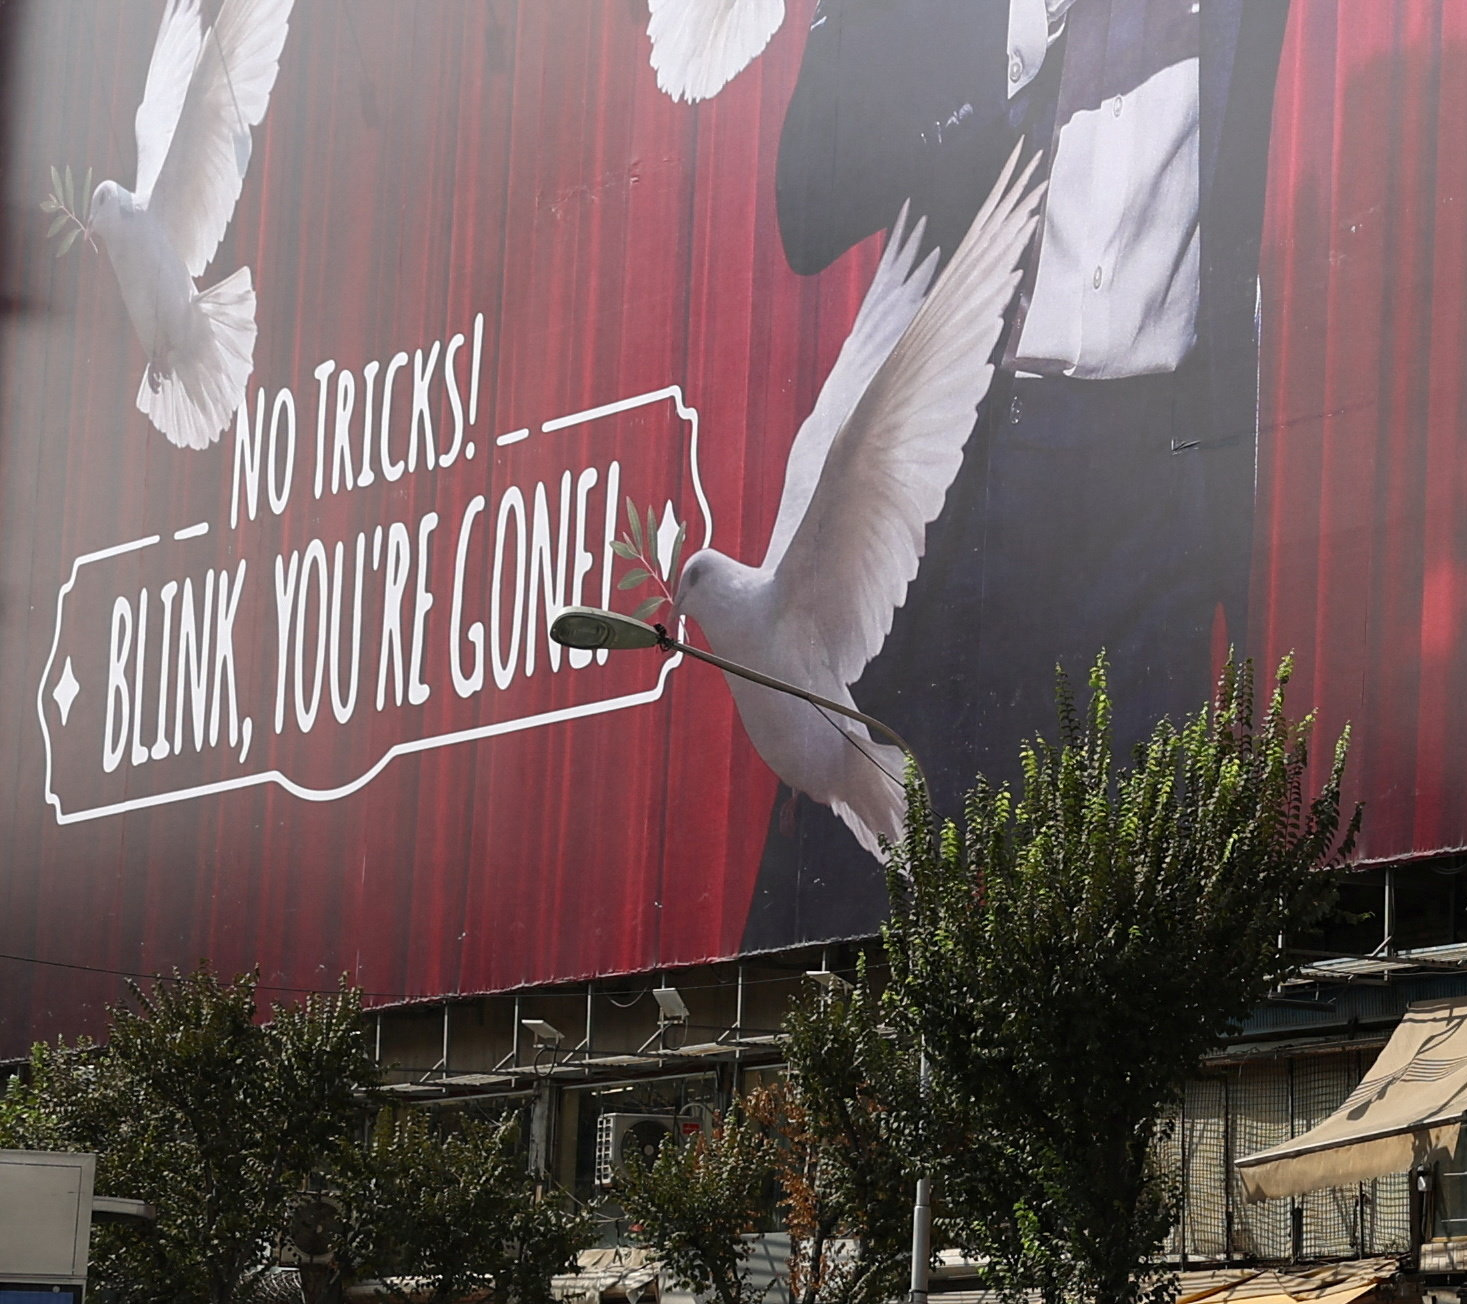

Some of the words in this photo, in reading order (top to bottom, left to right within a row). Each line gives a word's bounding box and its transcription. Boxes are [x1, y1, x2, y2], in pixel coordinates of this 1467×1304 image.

[230, 385, 298, 530] NO
[313, 312, 485, 501] TRICKS!
[103, 558, 253, 774] BLINK,
[273, 511, 439, 736] YOU'RE
[449, 460, 621, 700] GONE!
